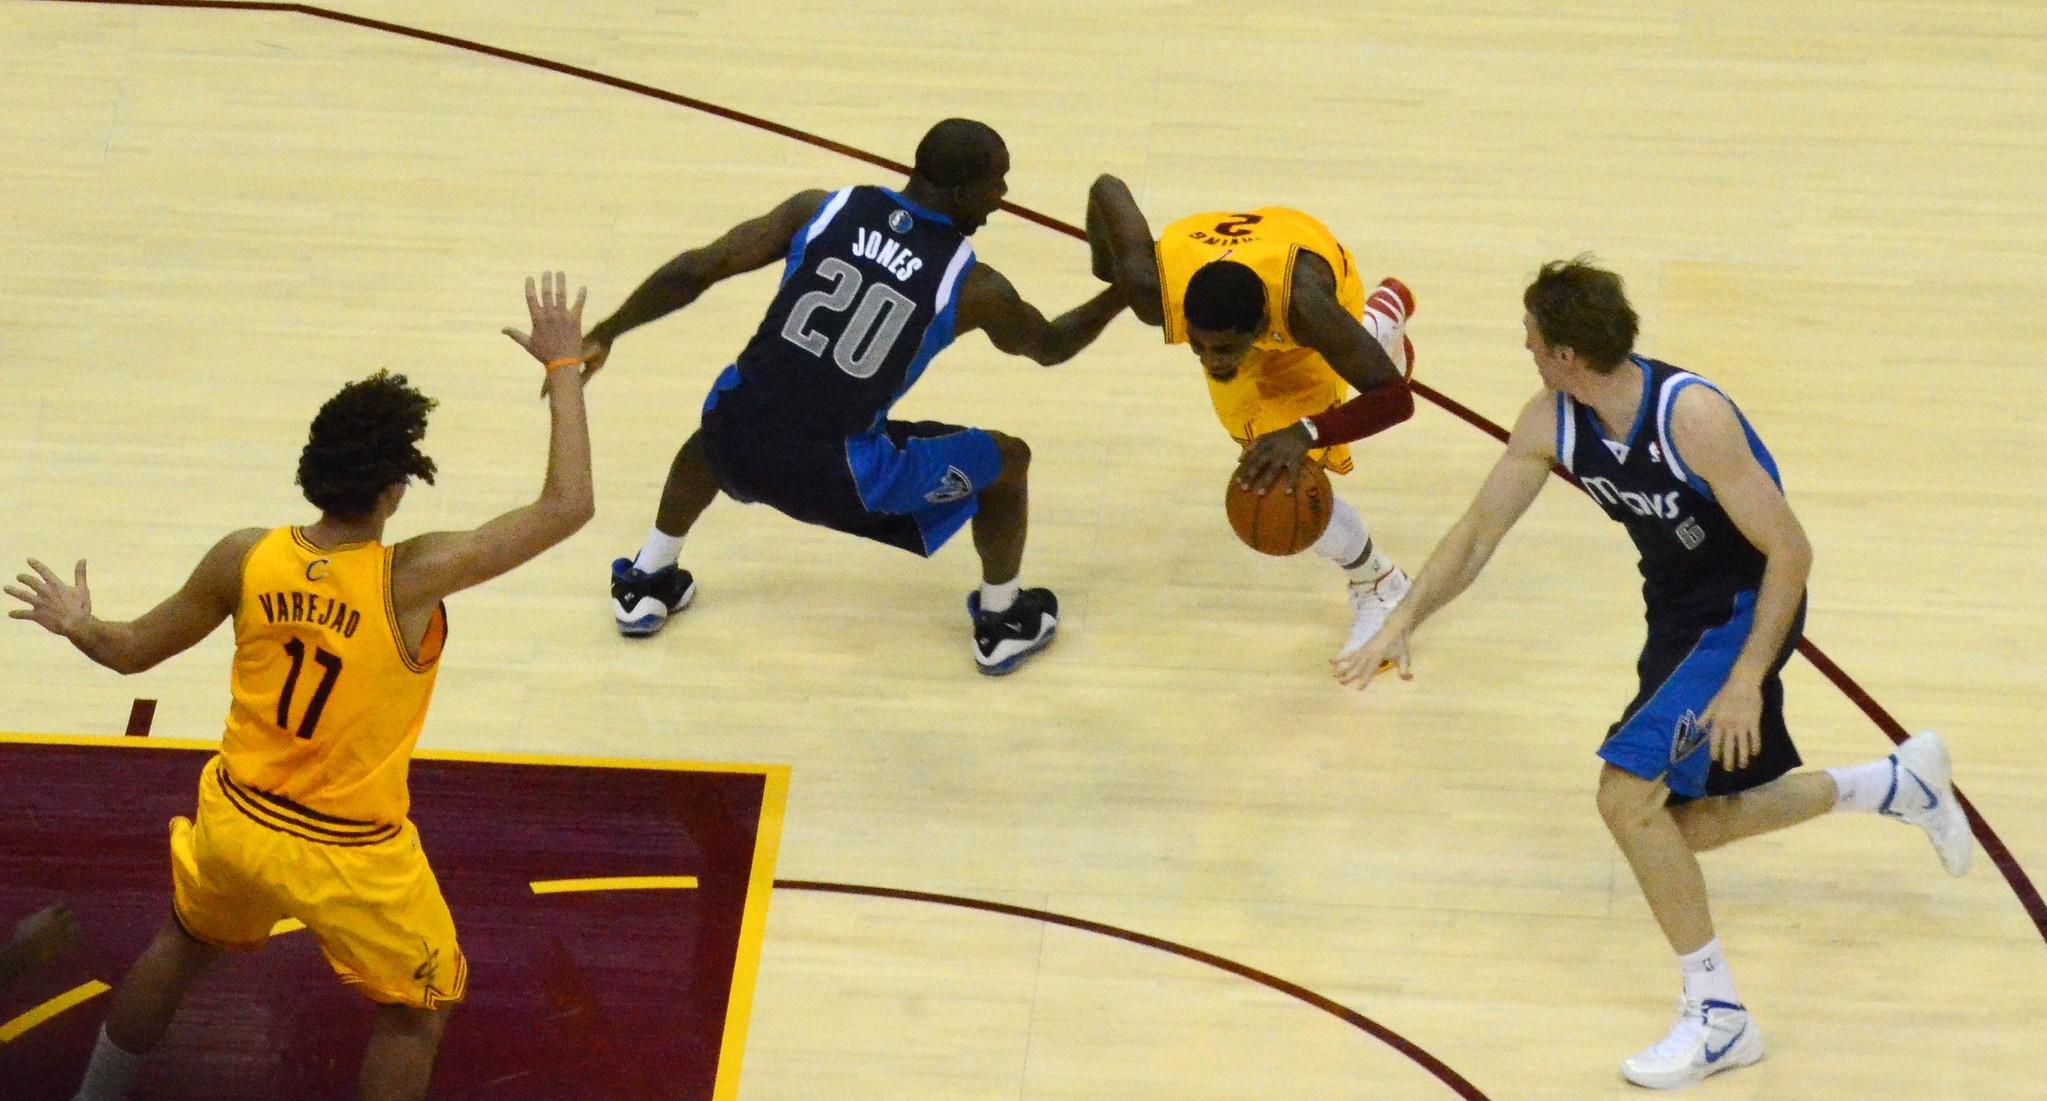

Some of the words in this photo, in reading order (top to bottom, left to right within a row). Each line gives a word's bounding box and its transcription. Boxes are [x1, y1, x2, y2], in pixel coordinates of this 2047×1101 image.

[852, 227, 923, 281] JONES
[1189, 232, 1261, 247] VING
[781, 257, 917, 378] 20
[1675, 516, 1705, 550] 6
[258, 592, 361, 638] VAREJAO
[277, 637, 343, 740] 17
